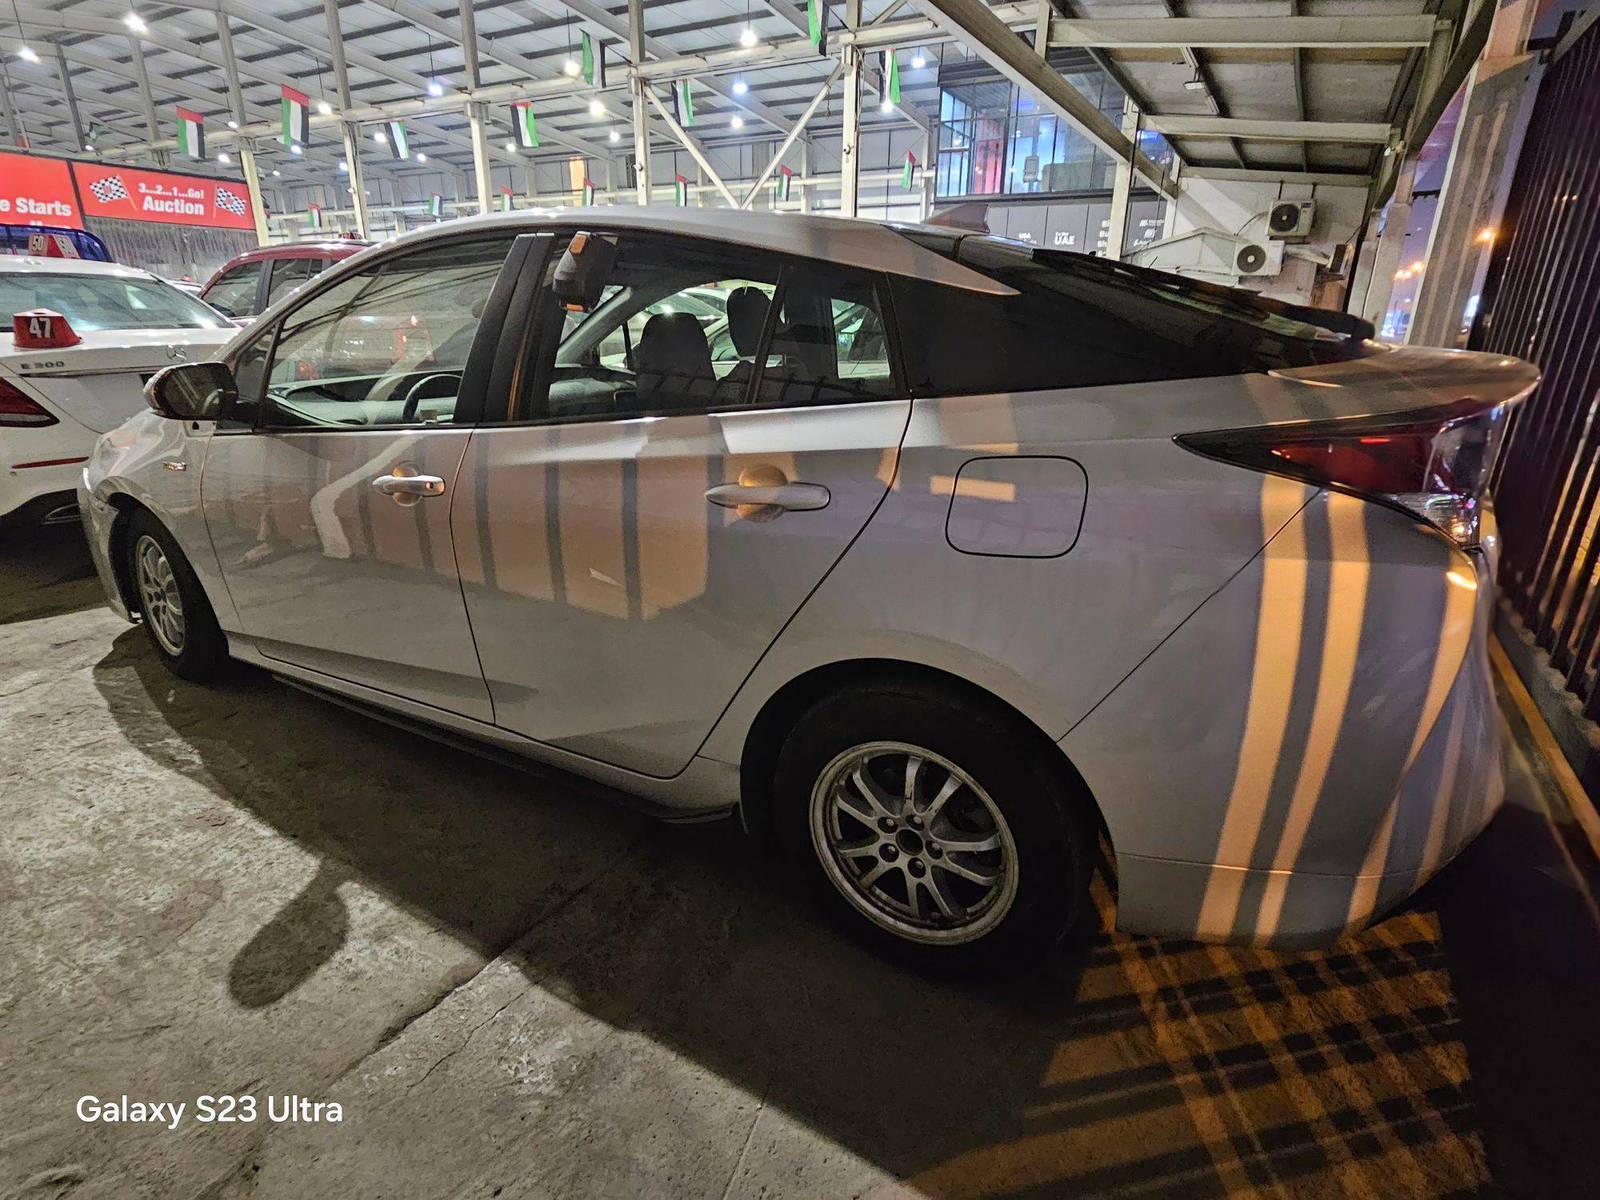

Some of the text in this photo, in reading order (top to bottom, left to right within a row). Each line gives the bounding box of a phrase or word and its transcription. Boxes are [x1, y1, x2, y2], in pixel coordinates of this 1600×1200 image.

[15, 197, 72, 216] Starts
[142, 195, 205, 216] Auction
[29, 317, 52, 339] 47
